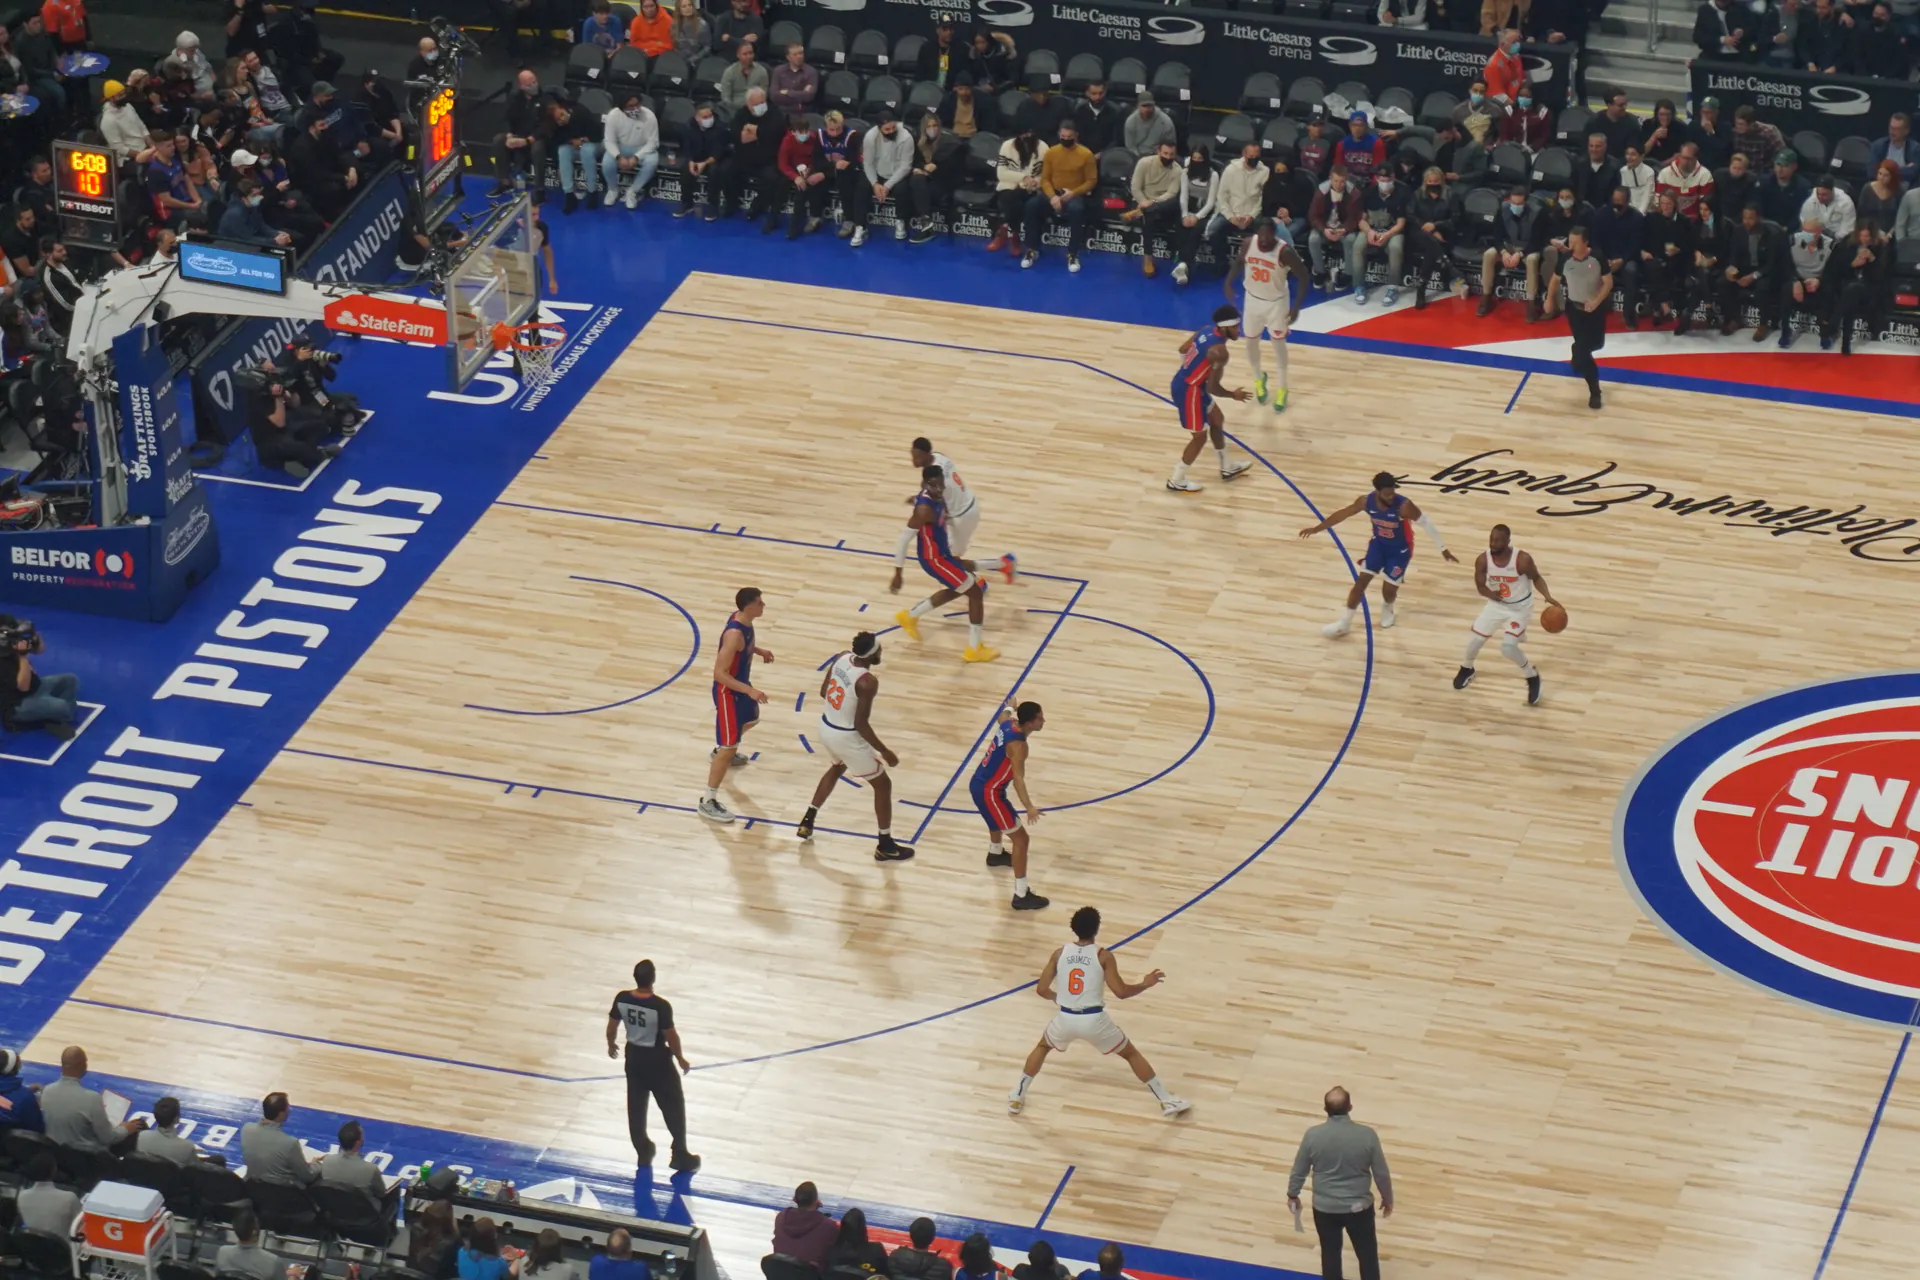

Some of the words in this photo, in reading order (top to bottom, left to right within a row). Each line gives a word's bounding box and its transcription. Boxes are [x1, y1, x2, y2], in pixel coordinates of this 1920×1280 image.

[1052, 4, 1088, 21] Little
[1089, 9, 1141, 28] Caesars
[1098, 26, 1141, 41] arena
[1223, 22, 1259, 40] Little
[1259, 28, 1312, 47] Caesars
[1268, 45, 1312, 60] arena
[1396, 43, 1433, 60] Little
[1434, 46, 1488, 66] Caesars
[1443, 63, 1484, 77] aren
[1708, 74, 1746, 90] Little
[1746, 78, 1802, 97] Caesars
[1757, 94, 1802, 110] arena
[71, 151, 107, 173] 6:08
[79, 172, 100, 195] 10
[953, 223, 992, 238] Caesars
[961, 213, 989, 228] Little
[1086, 238, 1127, 253] Caesars
[1095, 229, 1123, 244] Little
[1251, 266, 1270, 283] 30
[1880, 330, 1920, 346] Caesars
[1890, 321, 1919, 336] Little
[520, 376, 551, 412] UNITED
[545, 345, 588, 386] WHOLESALE
[584, 306, 623, 347] MORTGAGE
[141, 386, 158, 456] SPORTSBOOK
[129, 384, 152, 482] DRAFTKINGS
[11, 546, 91, 571] BELFOR
[13, 572, 65, 585] PROPERTY
[153, 479, 443, 707] PISTONS
[827, 678, 845, 711] 23
[1066, 955, 1092, 966] GRIMES
[1068, 968, 1085, 996] 6
[627, 1008, 646, 1028] 55
[103, 1221, 123, 1241] G
